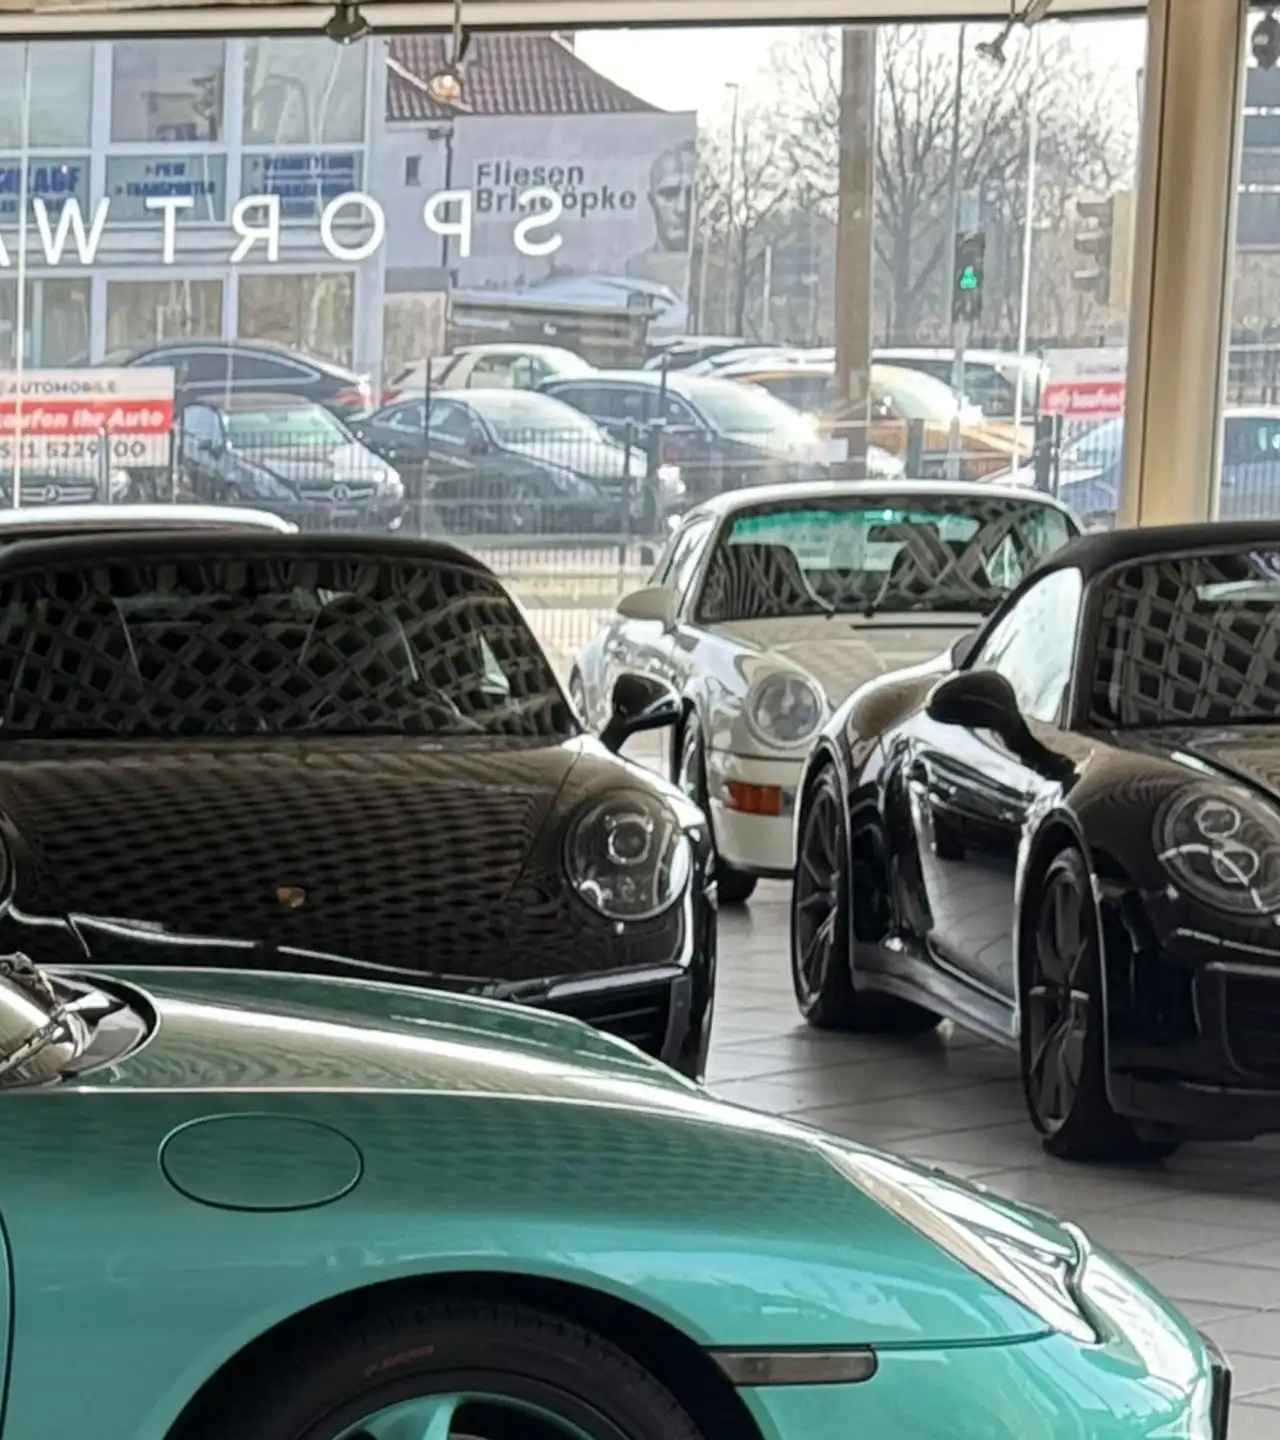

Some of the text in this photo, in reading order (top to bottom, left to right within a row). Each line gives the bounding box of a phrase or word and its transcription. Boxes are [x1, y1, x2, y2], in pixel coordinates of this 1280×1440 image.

[477, 159, 584, 186] Fliesen
[72, 408, 107, 428] Ihr
[107, 407, 166, 428] Auto
[46, 440, 147, 459] 522900
